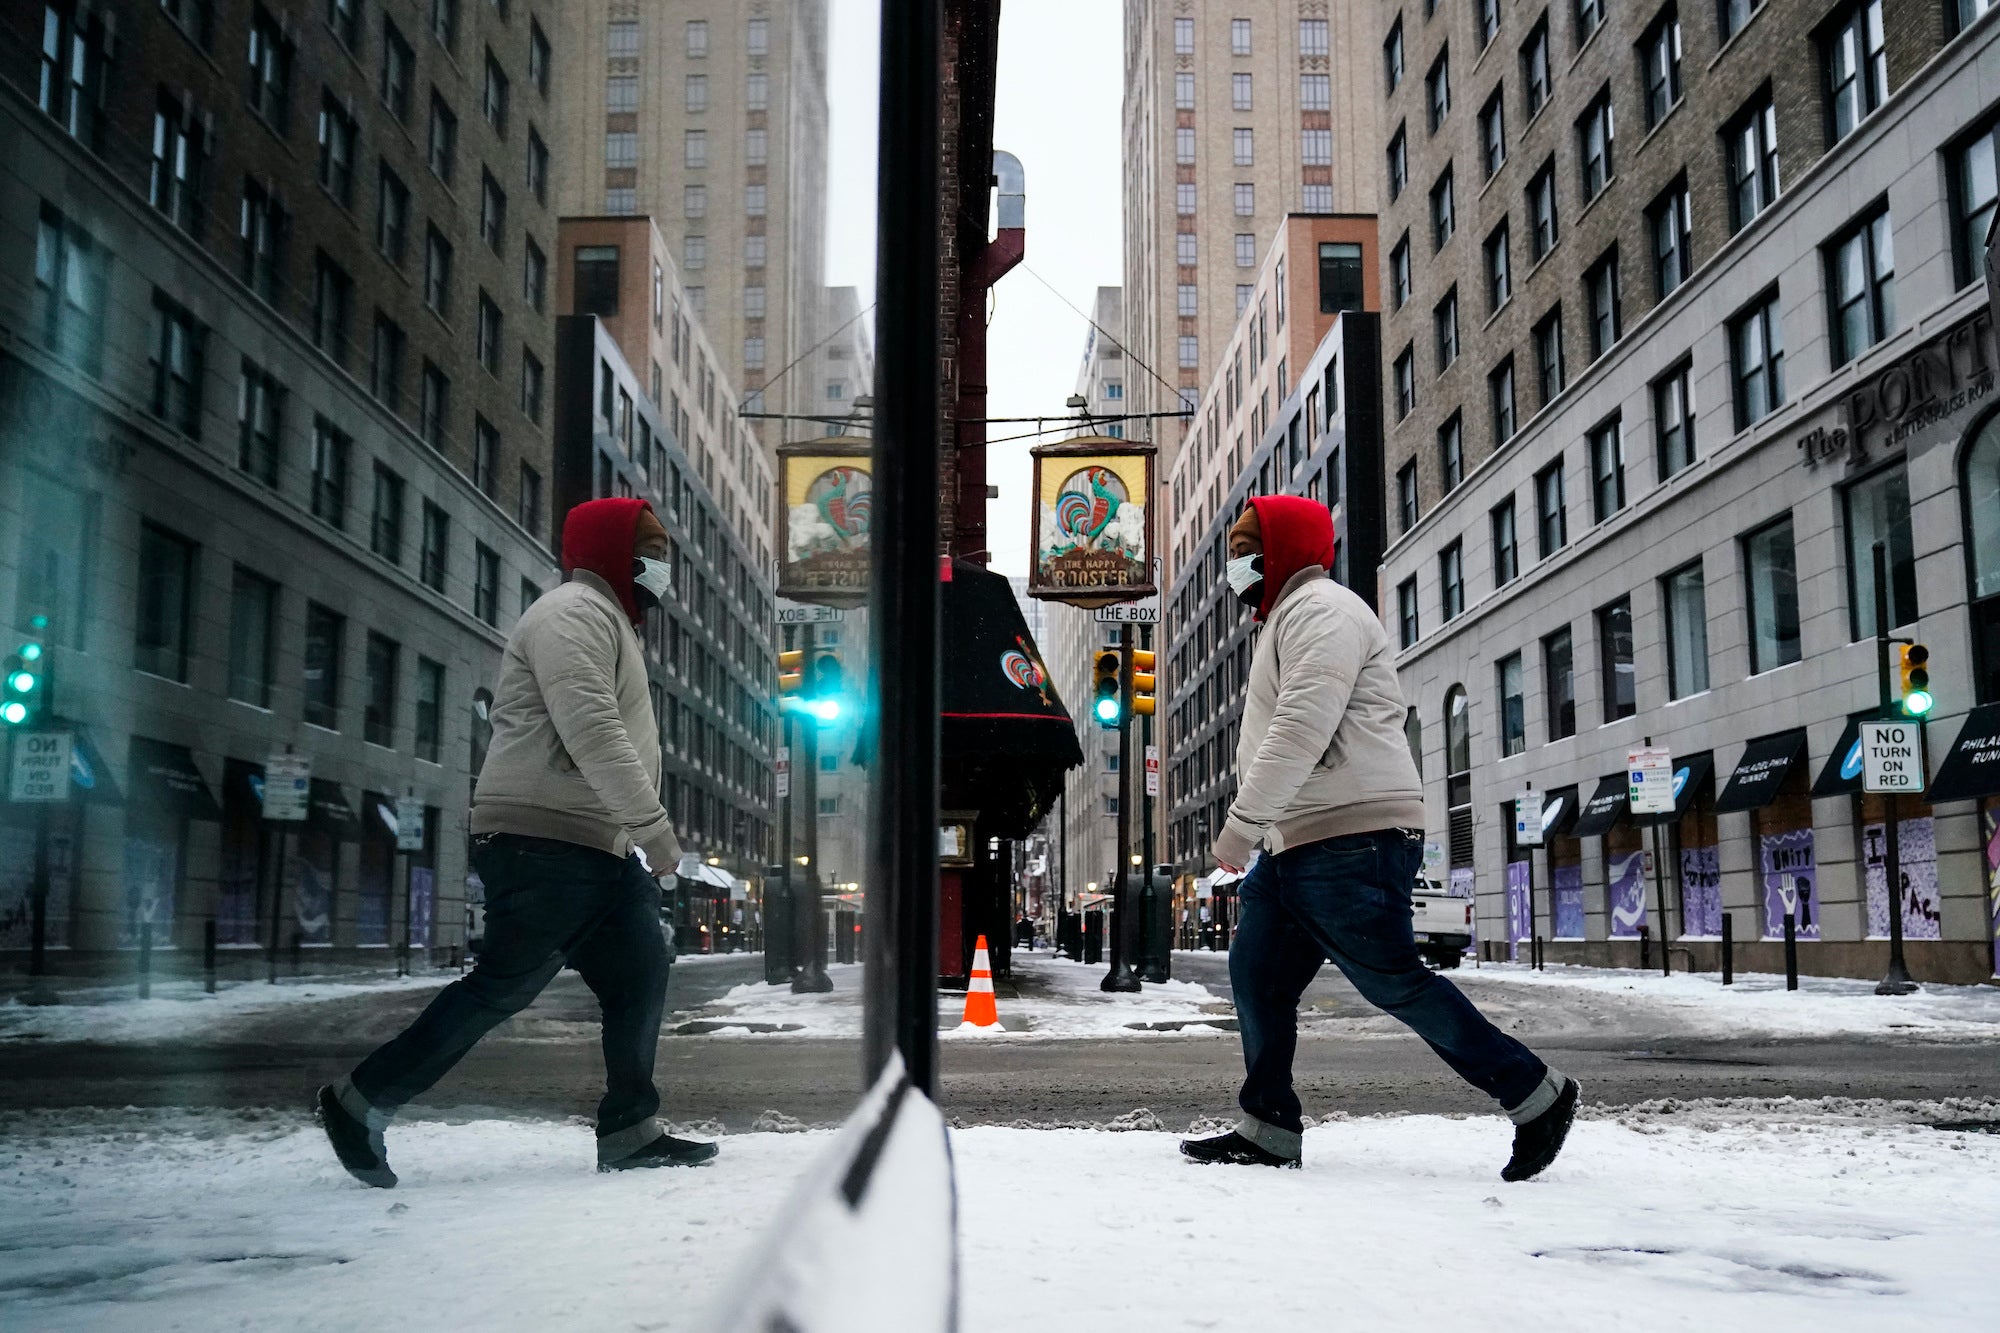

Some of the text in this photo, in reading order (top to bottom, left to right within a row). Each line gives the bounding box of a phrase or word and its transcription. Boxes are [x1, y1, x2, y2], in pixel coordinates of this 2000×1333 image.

[1797, 310, 1993, 468] The POINT
[1065, 560, 1117, 569] THE HAPPY
[1100, 607, 1157, 620] THE BOX
[1876, 728, 1905, 744] NO
[1871, 747, 1911, 758] TURN
[1882, 761, 1903, 772] ON
[1880, 775, 1909, 786] RED
